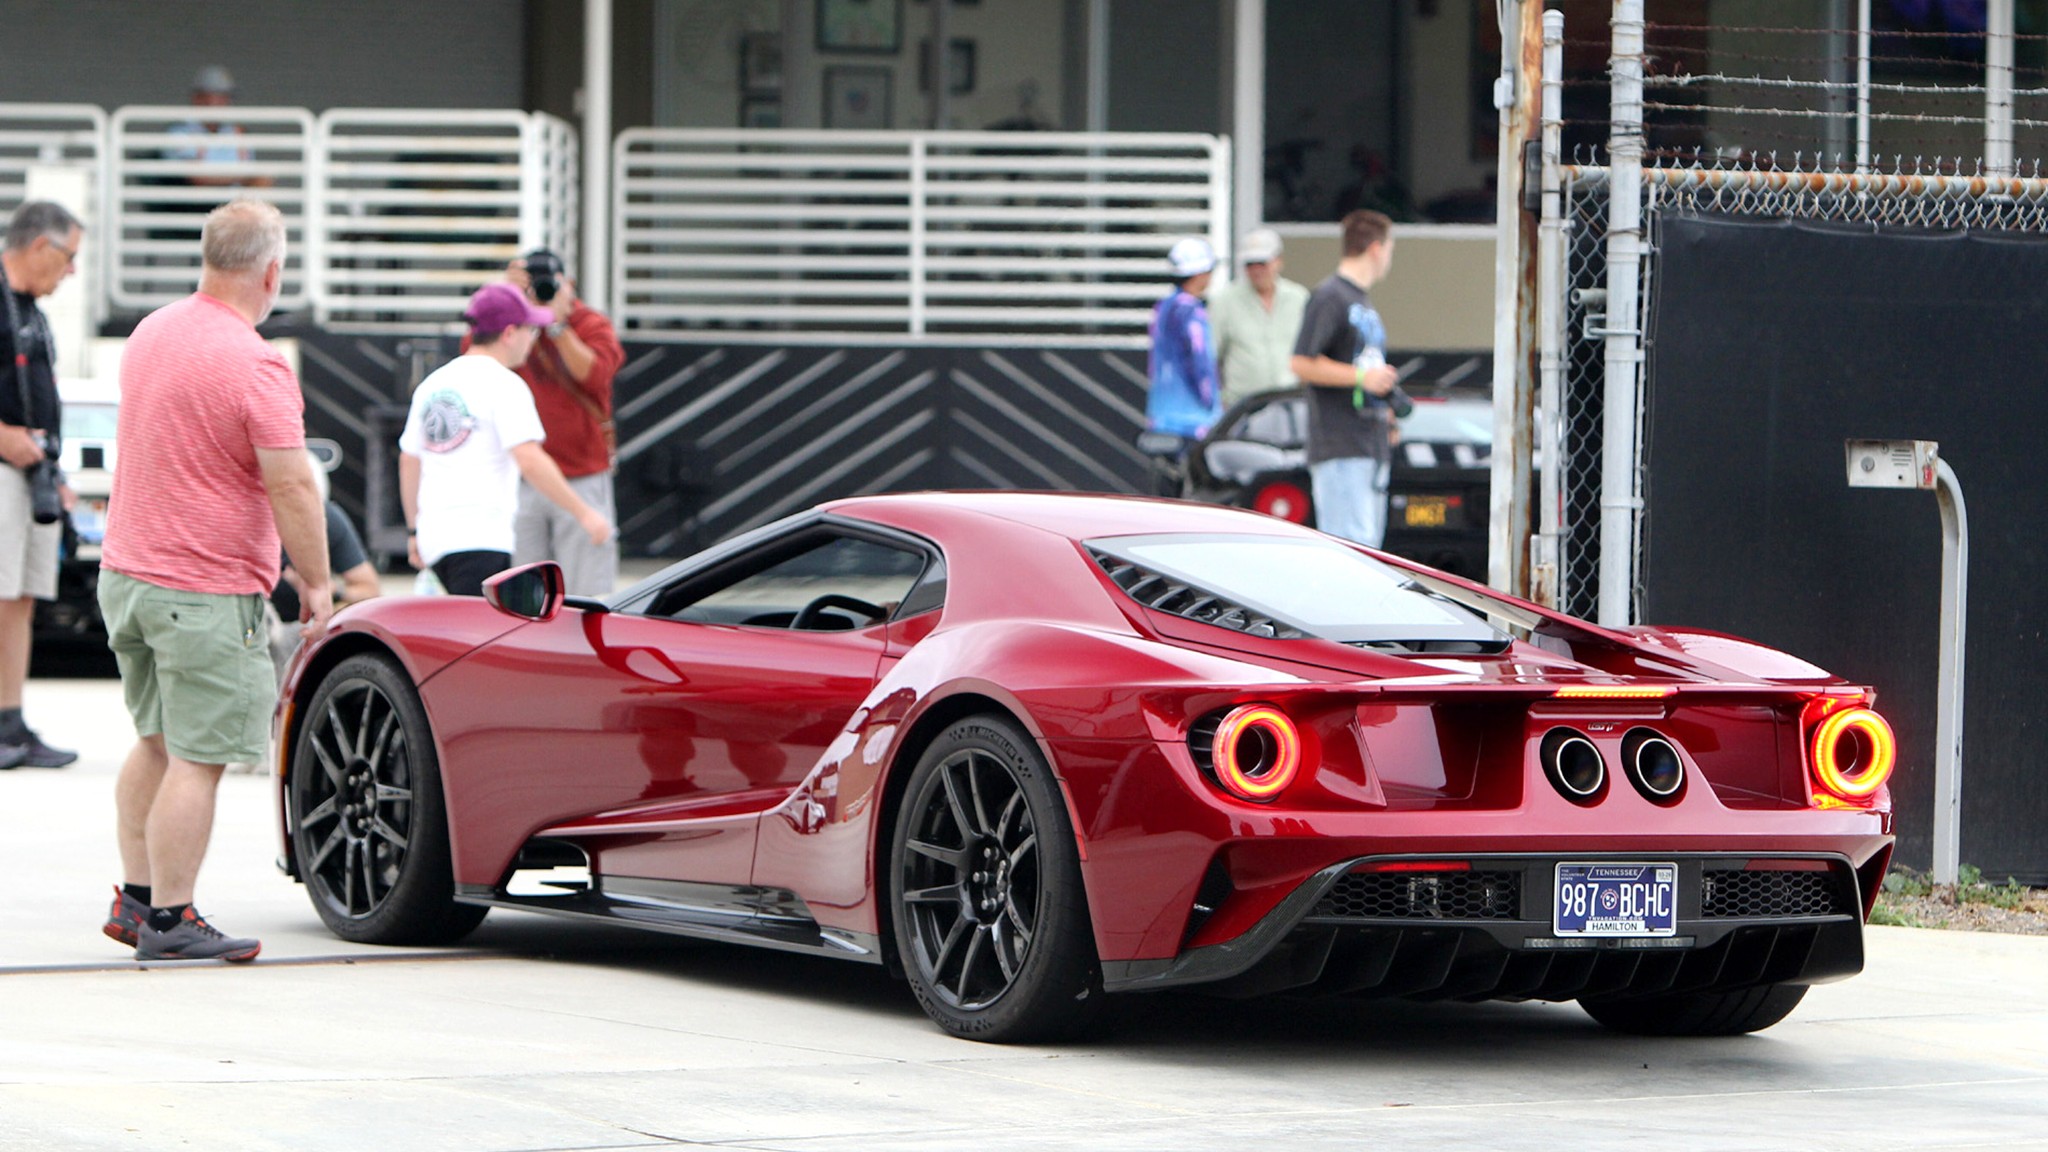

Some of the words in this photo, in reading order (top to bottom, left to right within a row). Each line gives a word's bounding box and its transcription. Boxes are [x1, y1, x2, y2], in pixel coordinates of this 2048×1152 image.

[1595, 868, 1639, 876] TENNESSEE
[1561, 883, 1600, 917] 987
[1619, 883, 1670, 917] BCHC
[1592, 922, 1638, 931] HAMILTON
